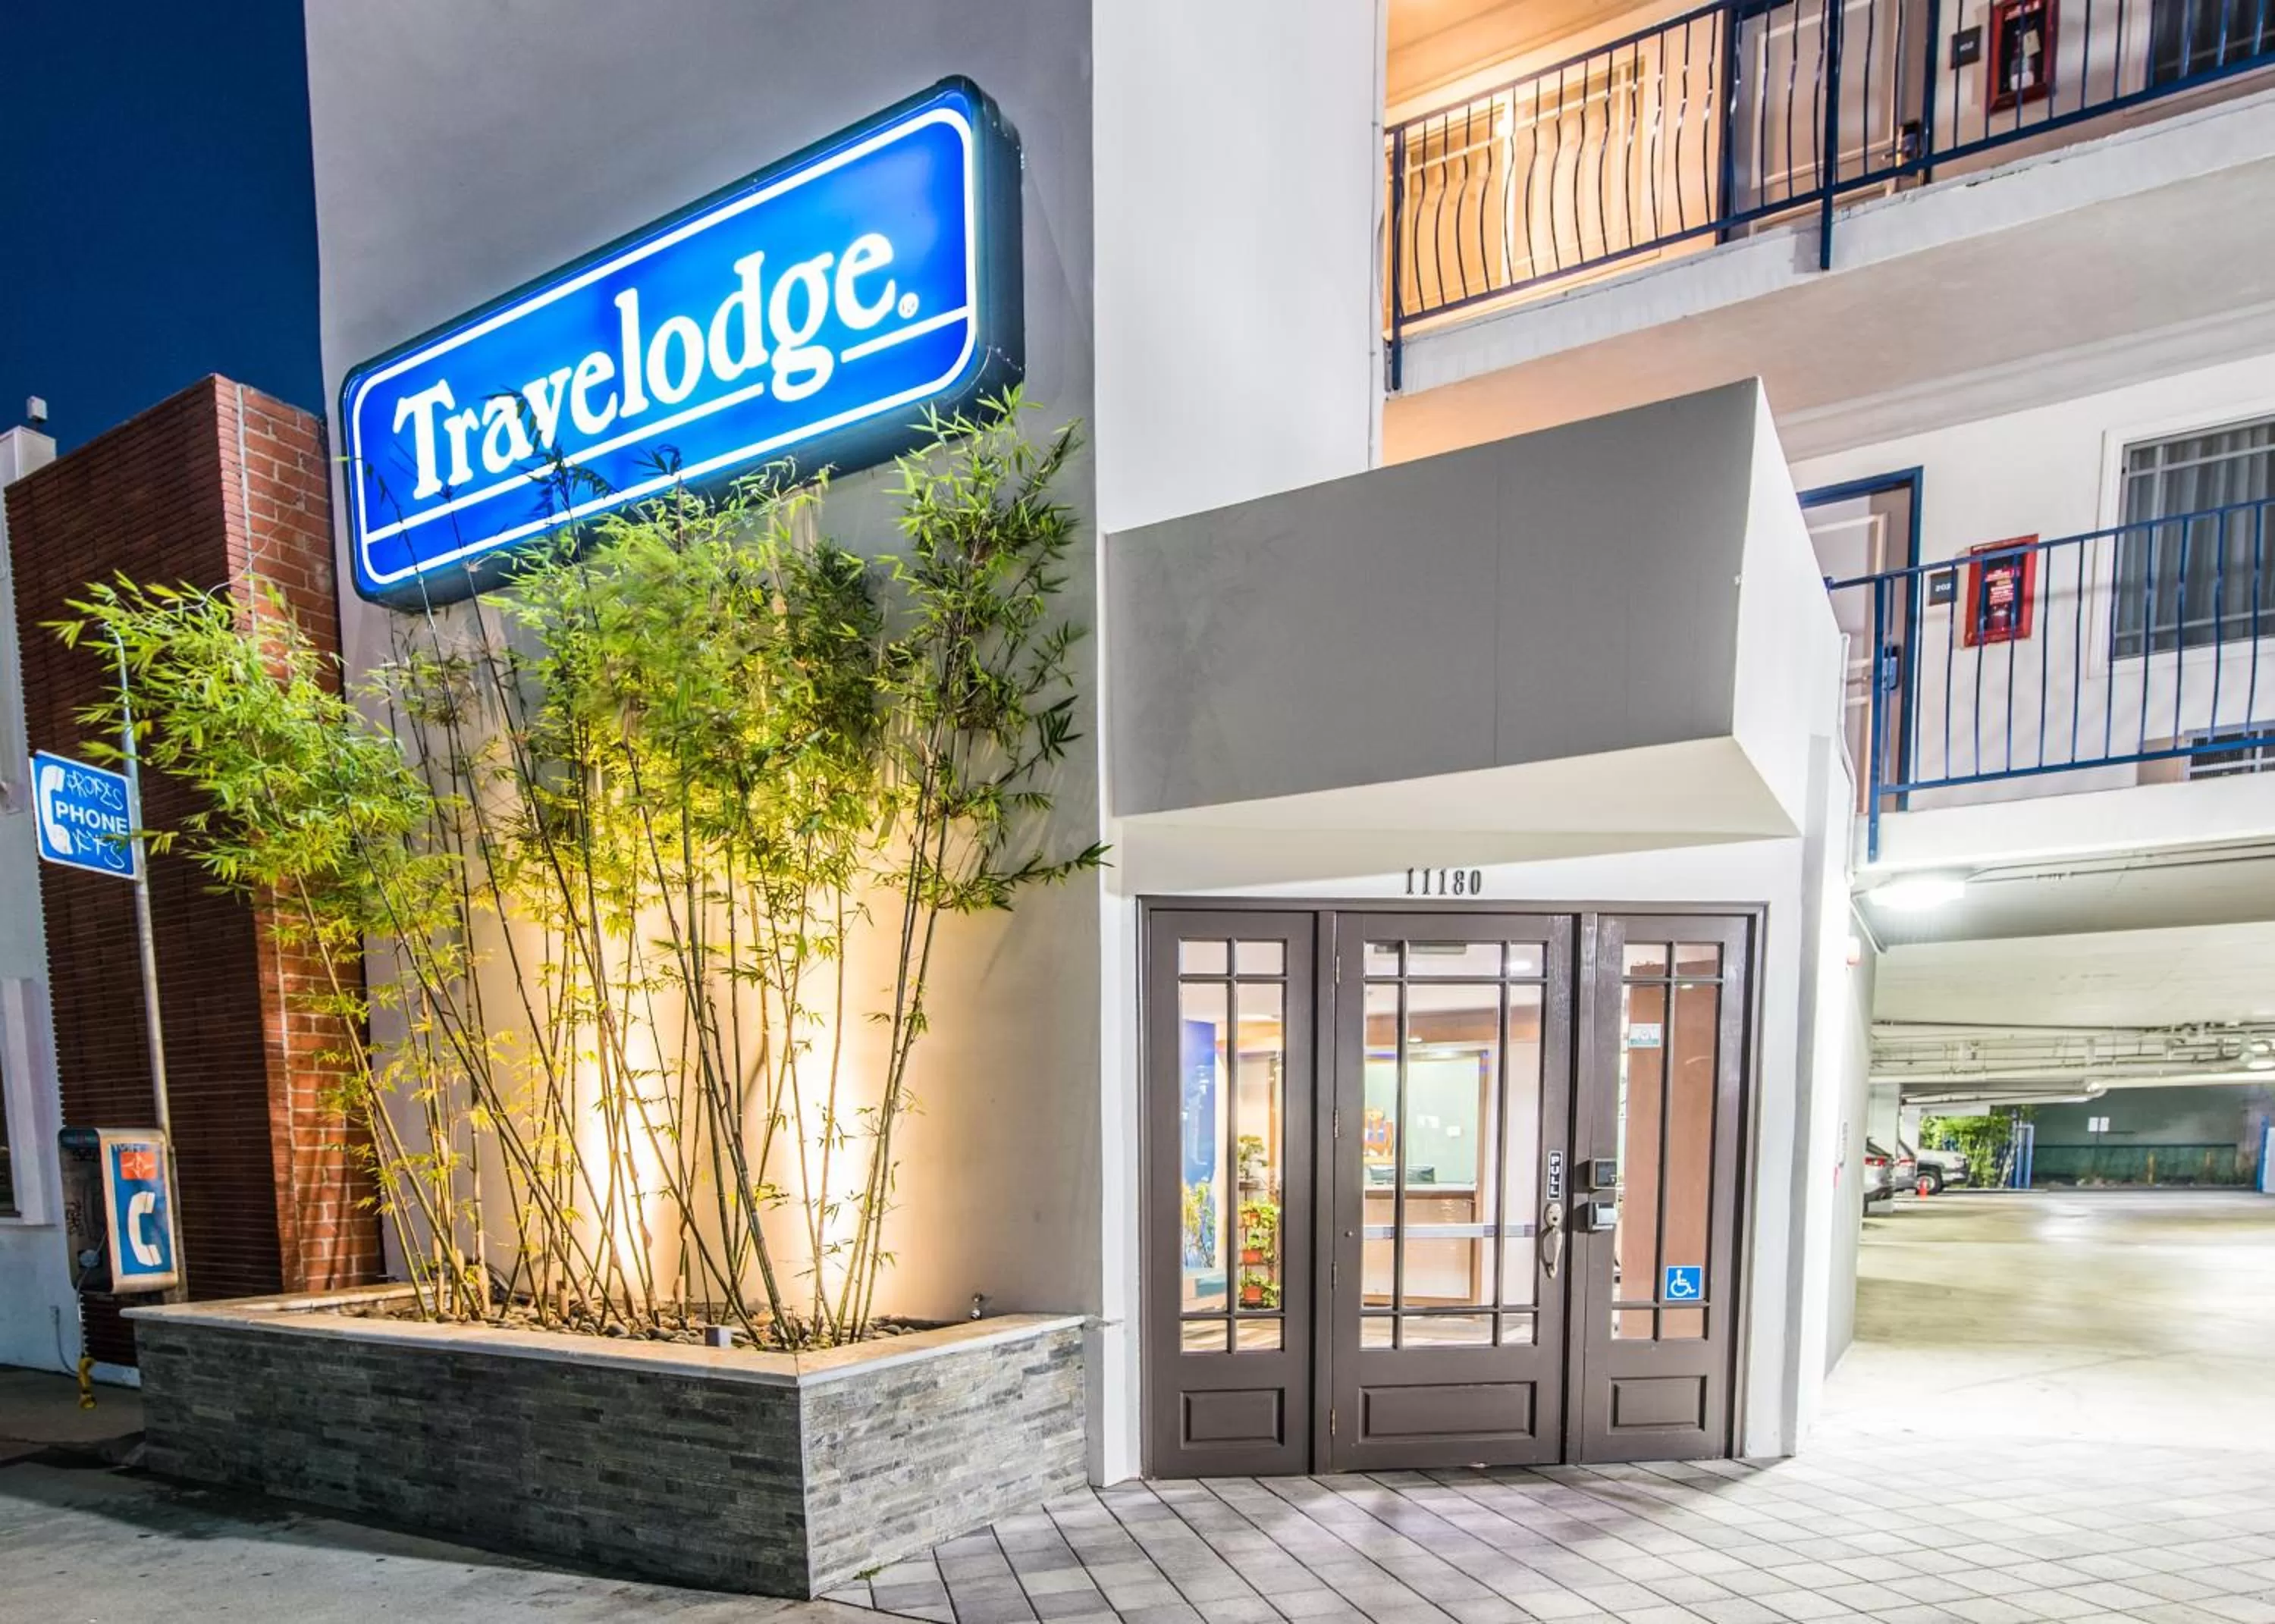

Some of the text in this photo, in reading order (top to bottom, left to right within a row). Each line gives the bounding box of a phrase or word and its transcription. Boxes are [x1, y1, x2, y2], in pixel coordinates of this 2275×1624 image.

[392, 232, 896, 500] Travelodge
[55, 801, 127, 836] PHONE
[1406, 867, 1482, 895] 11180
[1549, 1155, 1561, 1196] PULL
